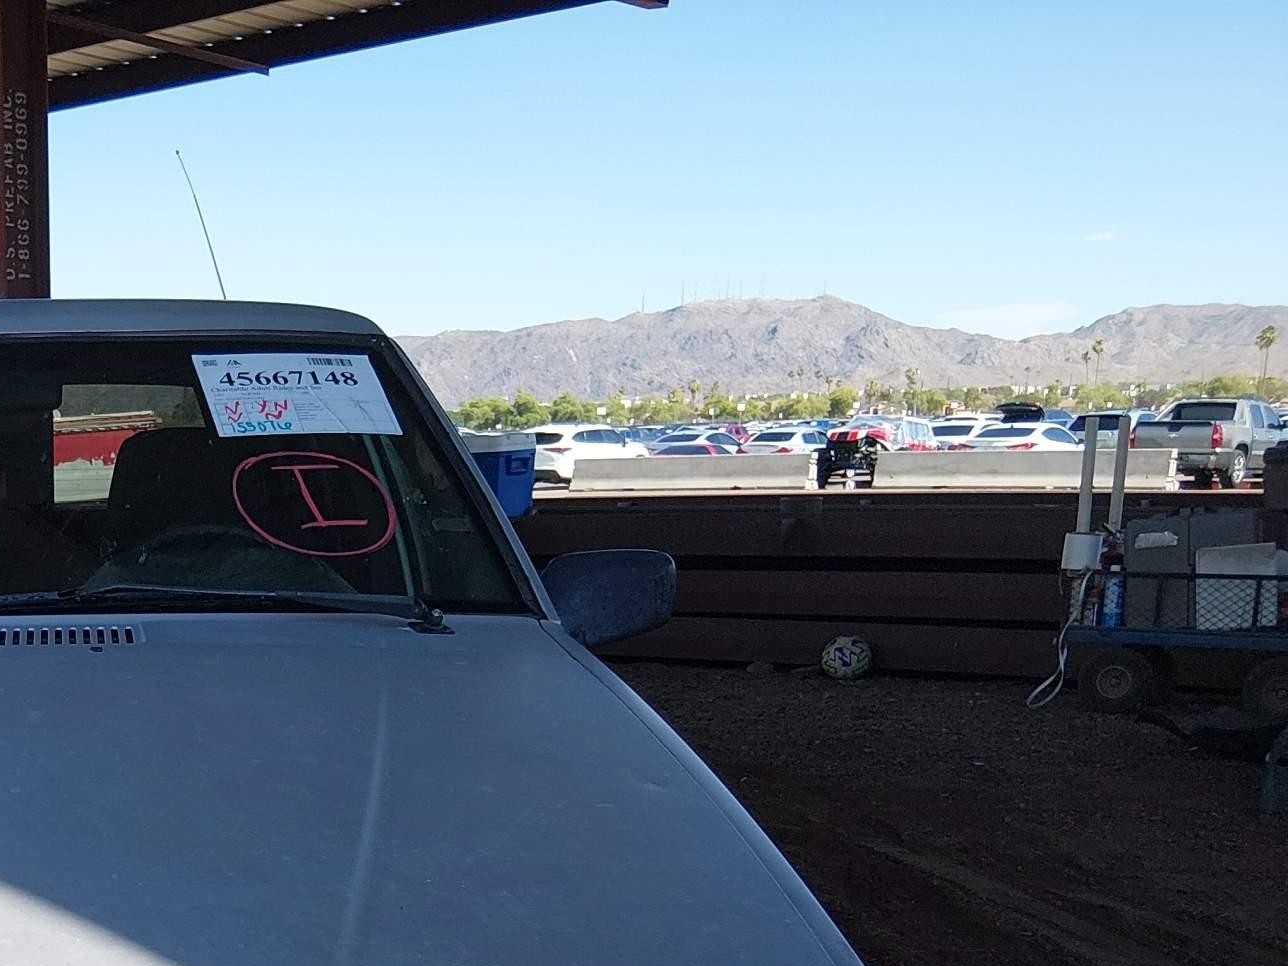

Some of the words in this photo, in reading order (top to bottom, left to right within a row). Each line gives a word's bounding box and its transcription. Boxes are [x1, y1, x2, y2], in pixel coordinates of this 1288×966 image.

[2, 88, 14, 130] INC.
[3, 142, 15, 227] PREFAB
[14, 92, 31, 278] 1-866-799-0969
[219, 370, 359, 387] 45667148
